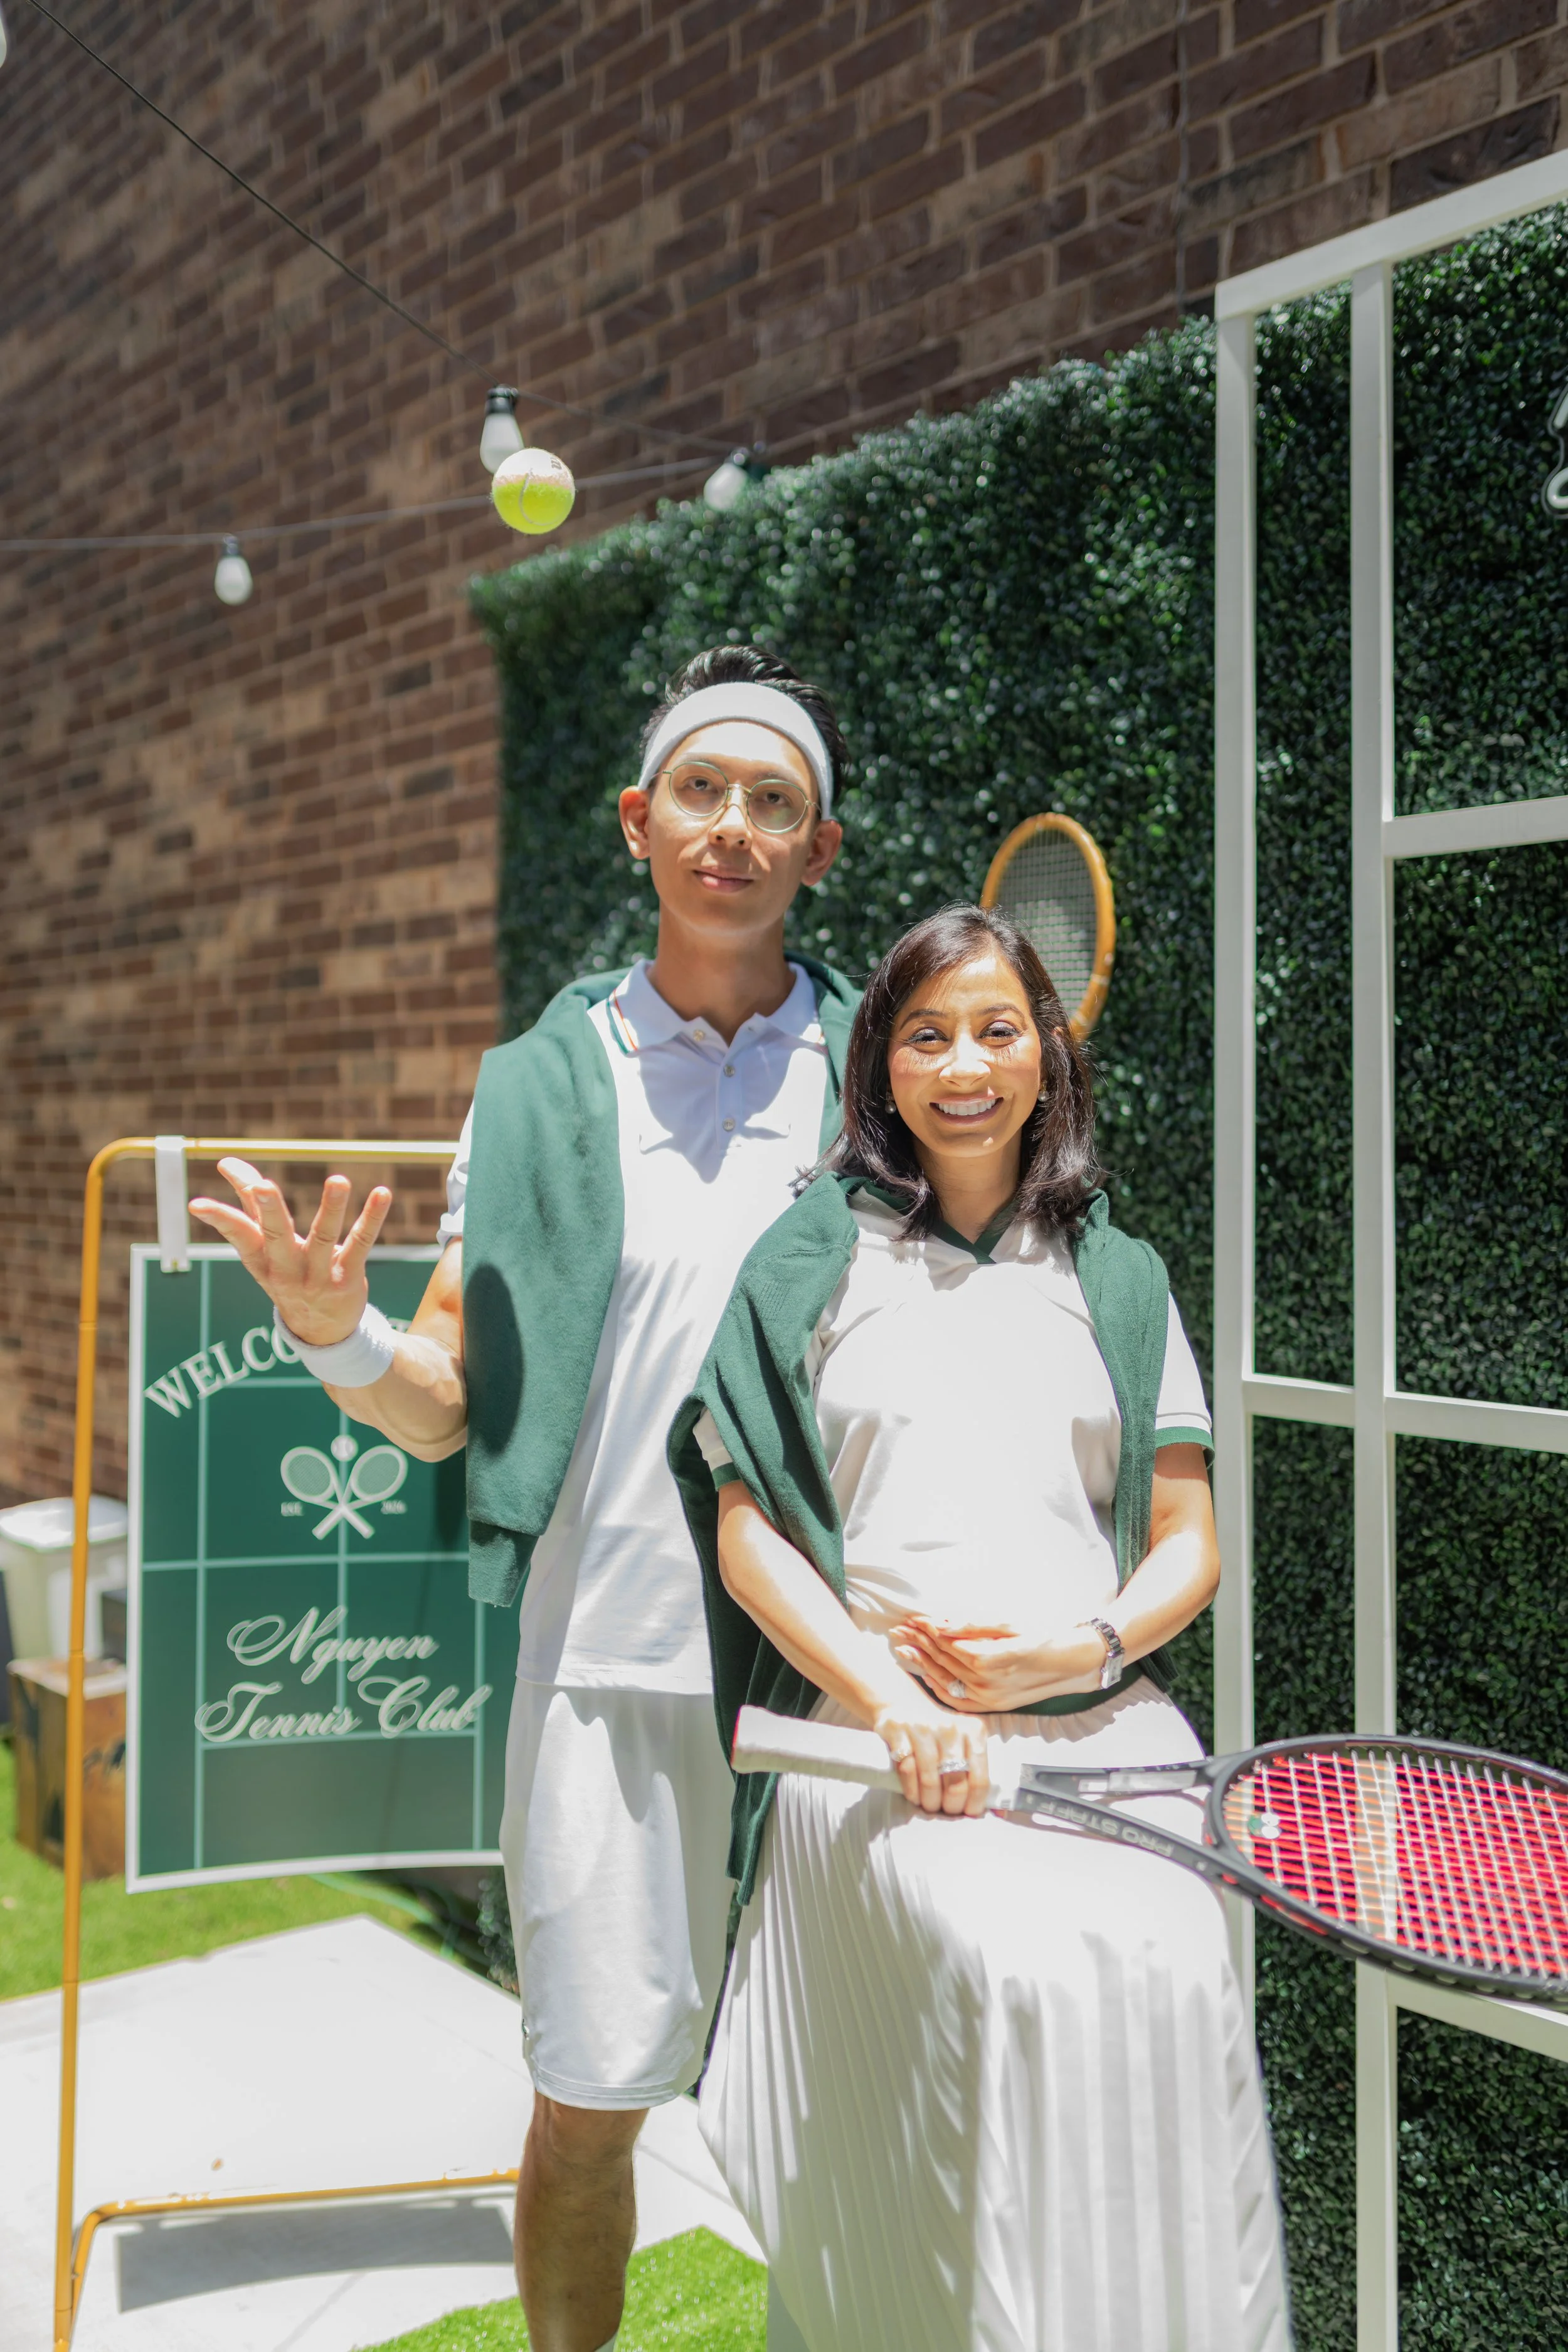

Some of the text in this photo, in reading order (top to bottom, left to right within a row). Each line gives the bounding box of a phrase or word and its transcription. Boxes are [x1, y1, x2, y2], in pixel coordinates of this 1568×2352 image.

[144, 1326, 300, 1418] WELCO
[226, 1605, 438, 1685] Nguyen
[194, 1675, 493, 1742] Tennis Club
[1036, 1801, 1174, 1858] PRO STAFF
